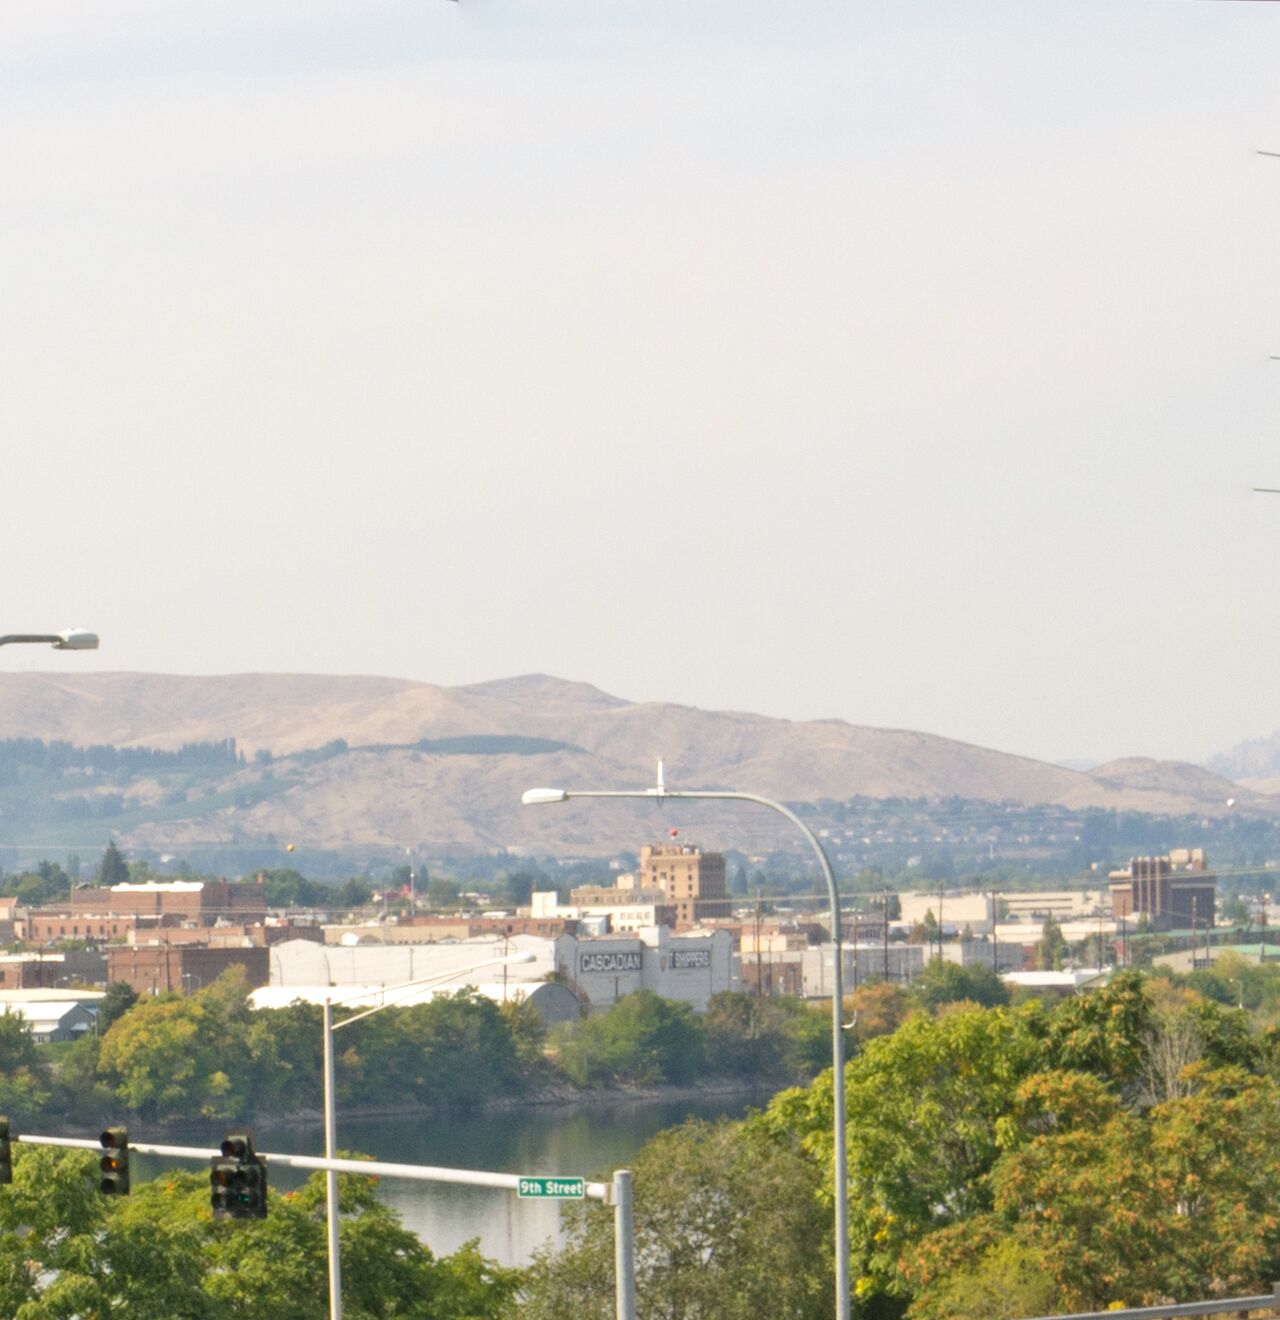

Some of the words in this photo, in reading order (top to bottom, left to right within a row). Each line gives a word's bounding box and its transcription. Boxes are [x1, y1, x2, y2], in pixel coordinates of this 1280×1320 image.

[582, 953, 641, 971] CASCADIAN
[674, 951, 709, 968] SHIPPERS
[520, 1181, 542, 1194] 9th
[546, 1181, 583, 1195] Street
